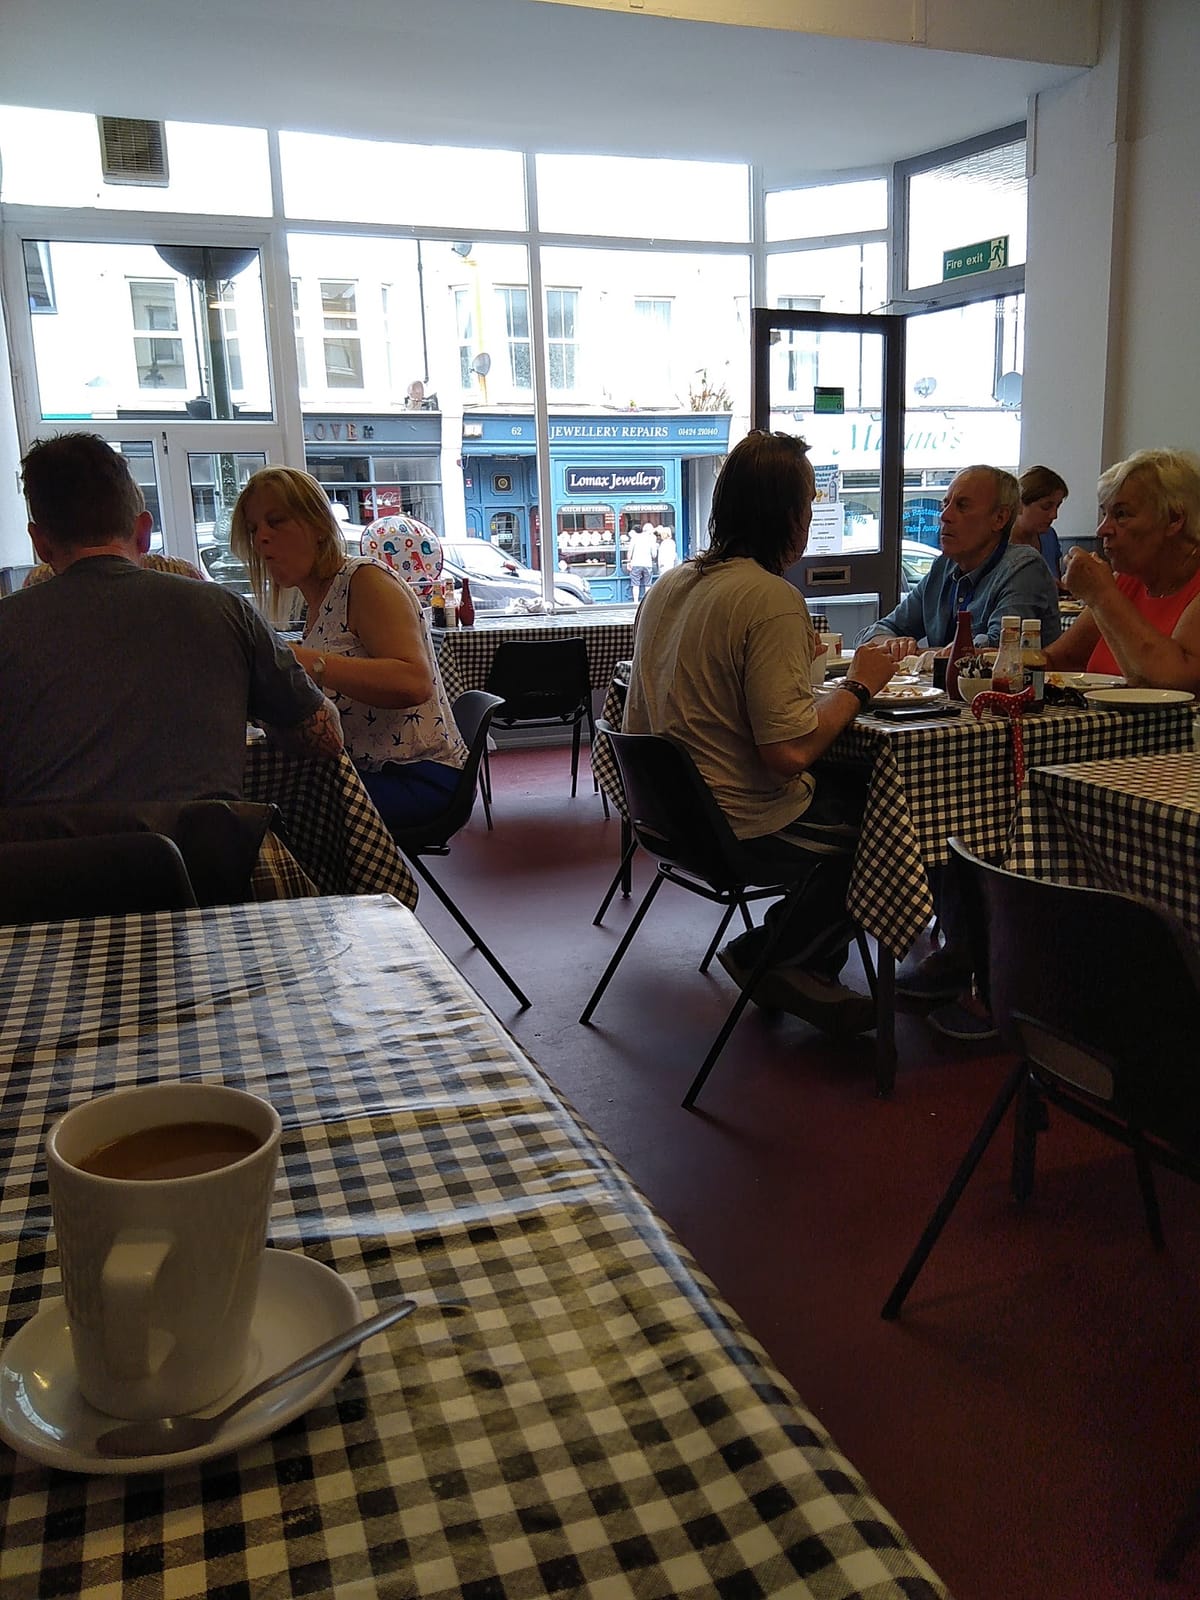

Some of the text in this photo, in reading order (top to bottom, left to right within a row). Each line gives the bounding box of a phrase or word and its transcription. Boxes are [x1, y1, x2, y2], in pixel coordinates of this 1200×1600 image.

[946, 252, 984, 271] Fire exit
[511, 426, 522, 436] 62
[548, 426, 619, 440] JEWELLERY
[621, 426, 669, 437] REPAIRS
[570, 471, 661, 490] Lomax Jewellery
